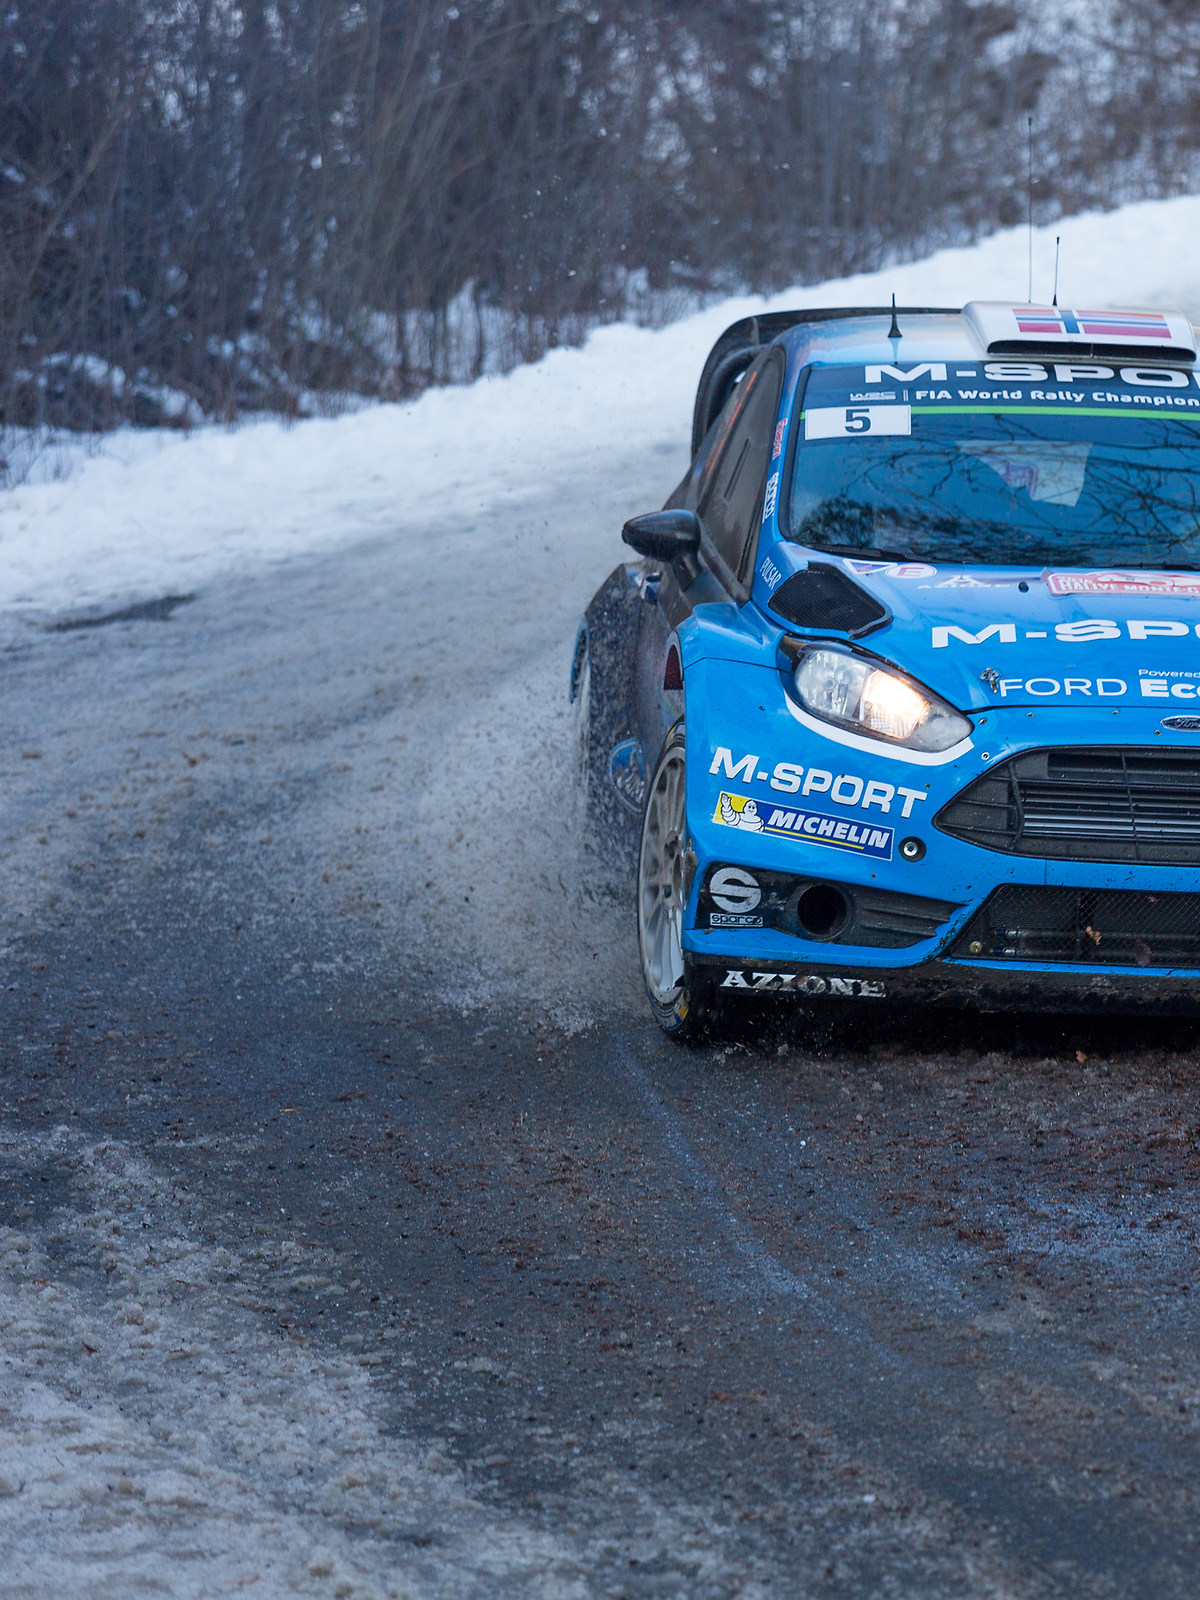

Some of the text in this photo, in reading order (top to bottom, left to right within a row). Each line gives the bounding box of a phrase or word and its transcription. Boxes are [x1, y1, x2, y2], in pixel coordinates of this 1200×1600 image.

[915, 390, 952, 400] FIA
[958, 390, 1023, 400] World
[1030, 390, 1085, 403] Rally
[845, 408, 872, 433] 5
[759, 556, 783, 590] PULSAR
[1000, 677, 1128, 697] FORD
[708, 746, 928, 818] M-SPORT
[767, 809, 890, 849] MICHELIN
[710, 914, 763, 926] sparco
[720, 970, 886, 997] AZIONE
